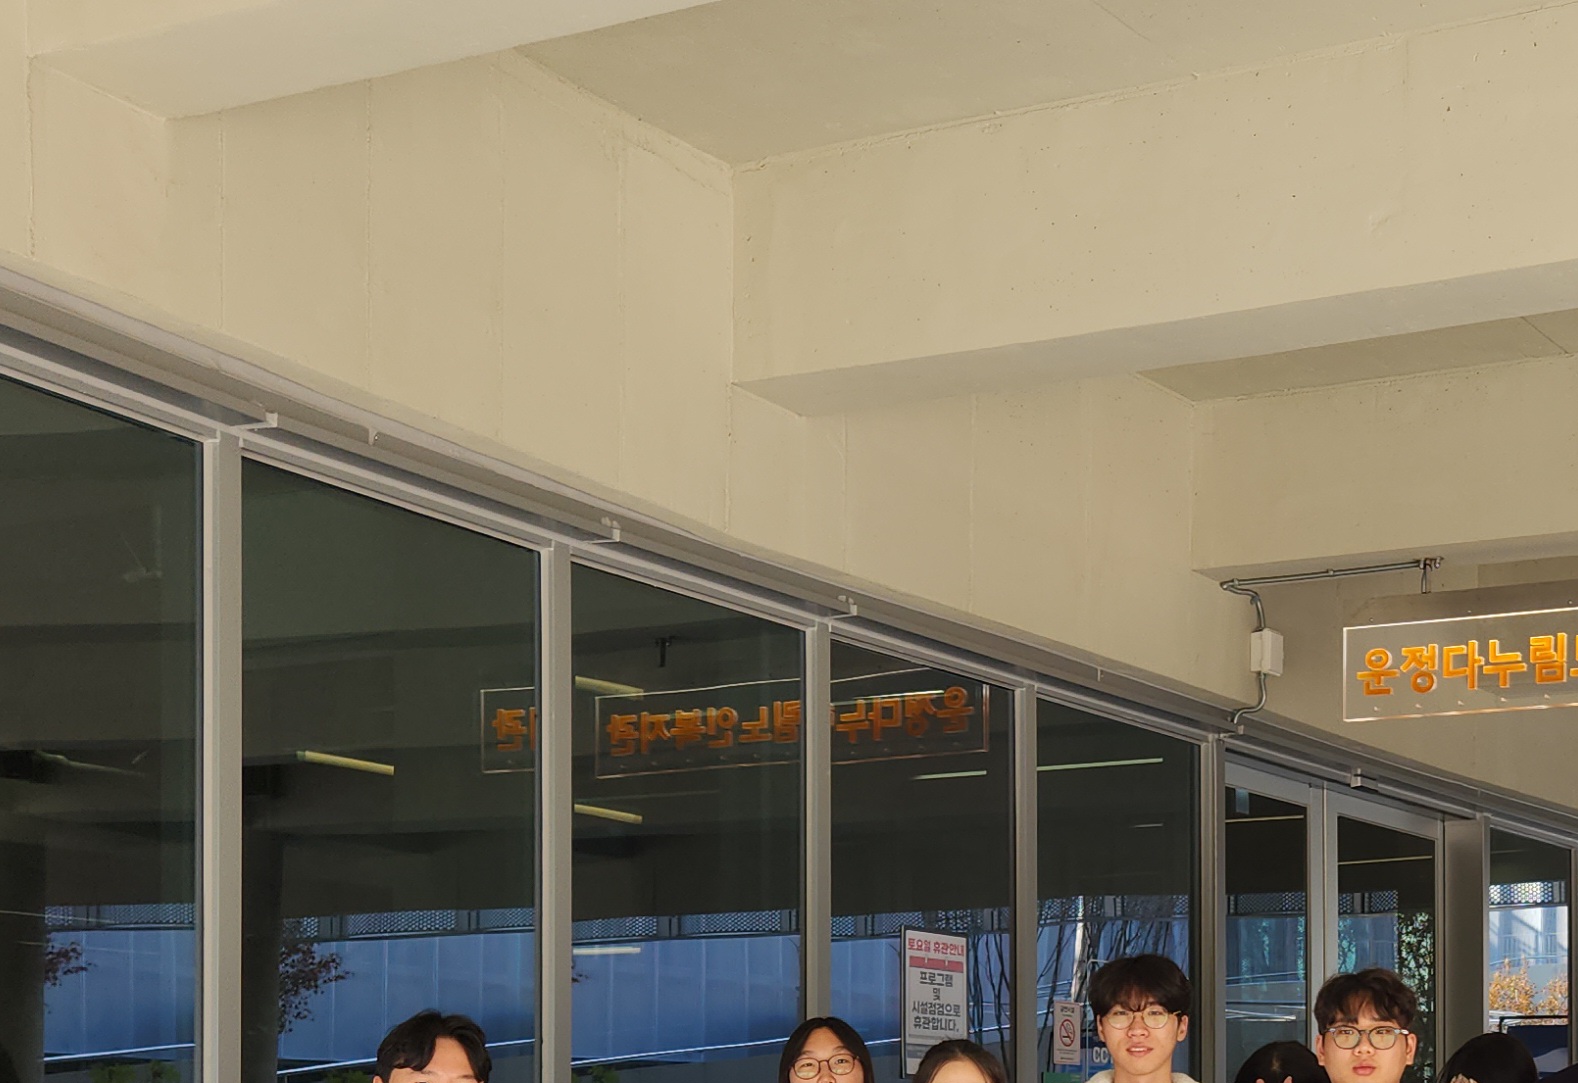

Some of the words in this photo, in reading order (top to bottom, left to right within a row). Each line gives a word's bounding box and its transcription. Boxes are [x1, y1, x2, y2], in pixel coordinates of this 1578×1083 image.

[908, 938, 931, 952] 토요일
[934, 941, 965, 956] 휴관안내
[920, 971, 953, 987] 프로그램
[933, 988, 941, 1001] 및
[912, 1001, 961, 1017] 시설점검으로
[913, 1016, 959, 1032] 휴관합니다.
[1092, 1046, 1113, 1064] CC
